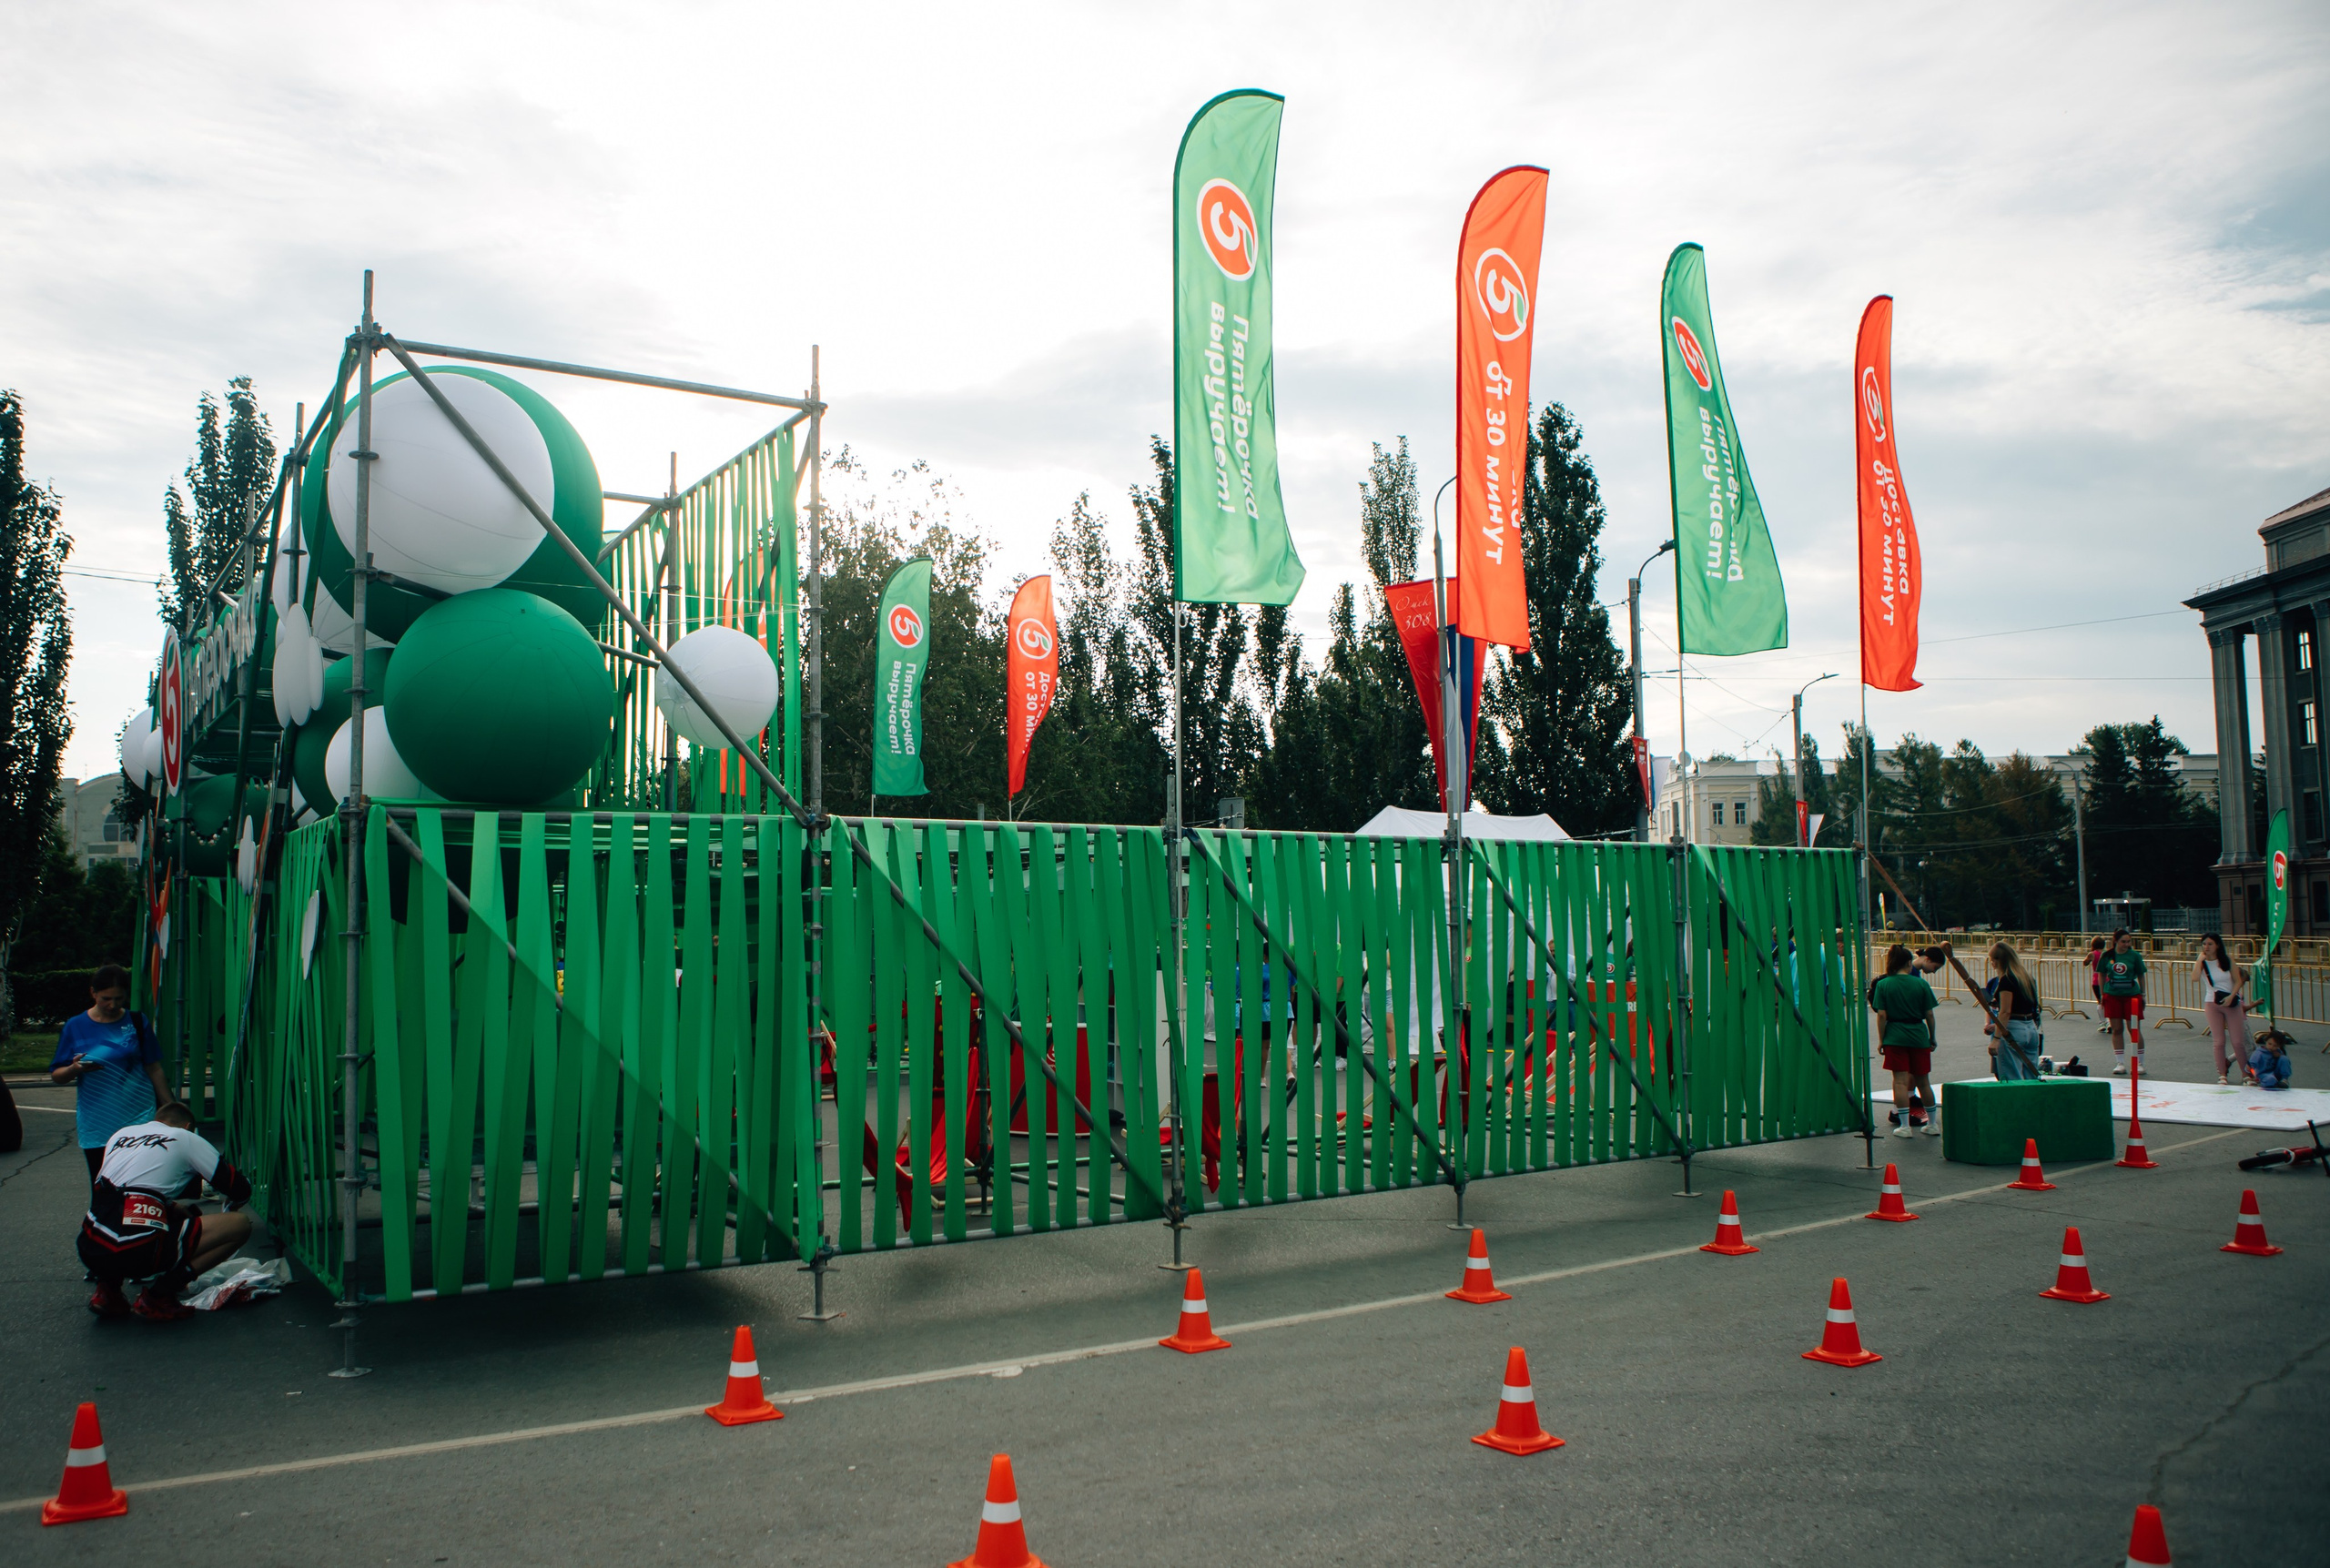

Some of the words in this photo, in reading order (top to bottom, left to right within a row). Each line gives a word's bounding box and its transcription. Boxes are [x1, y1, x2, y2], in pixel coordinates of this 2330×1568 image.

[1203, 300, 1236, 514] выручает!
[1485, 360, 1504, 400] от
[1231, 313, 1260, 521] Пятёрочка
[1485, 407, 1506, 447] 30
[1698, 406, 1724, 580] выручает!
[1871, 460, 1886, 491] от
[1482, 454, 1504, 565] минут
[1879, 495, 1893, 528] 30
[1883, 465, 1910, 595] Доставка
[1879, 533, 1894, 627] минут
[1402, 612, 1432, 632] 308
[886, 660, 902, 755] выручает!
[898, 662, 917, 755] Пятёрочка
[1025, 671, 1036, 690] от
[1026, 693, 1038, 712] 30
[133, 1202, 163, 1218] 2167
